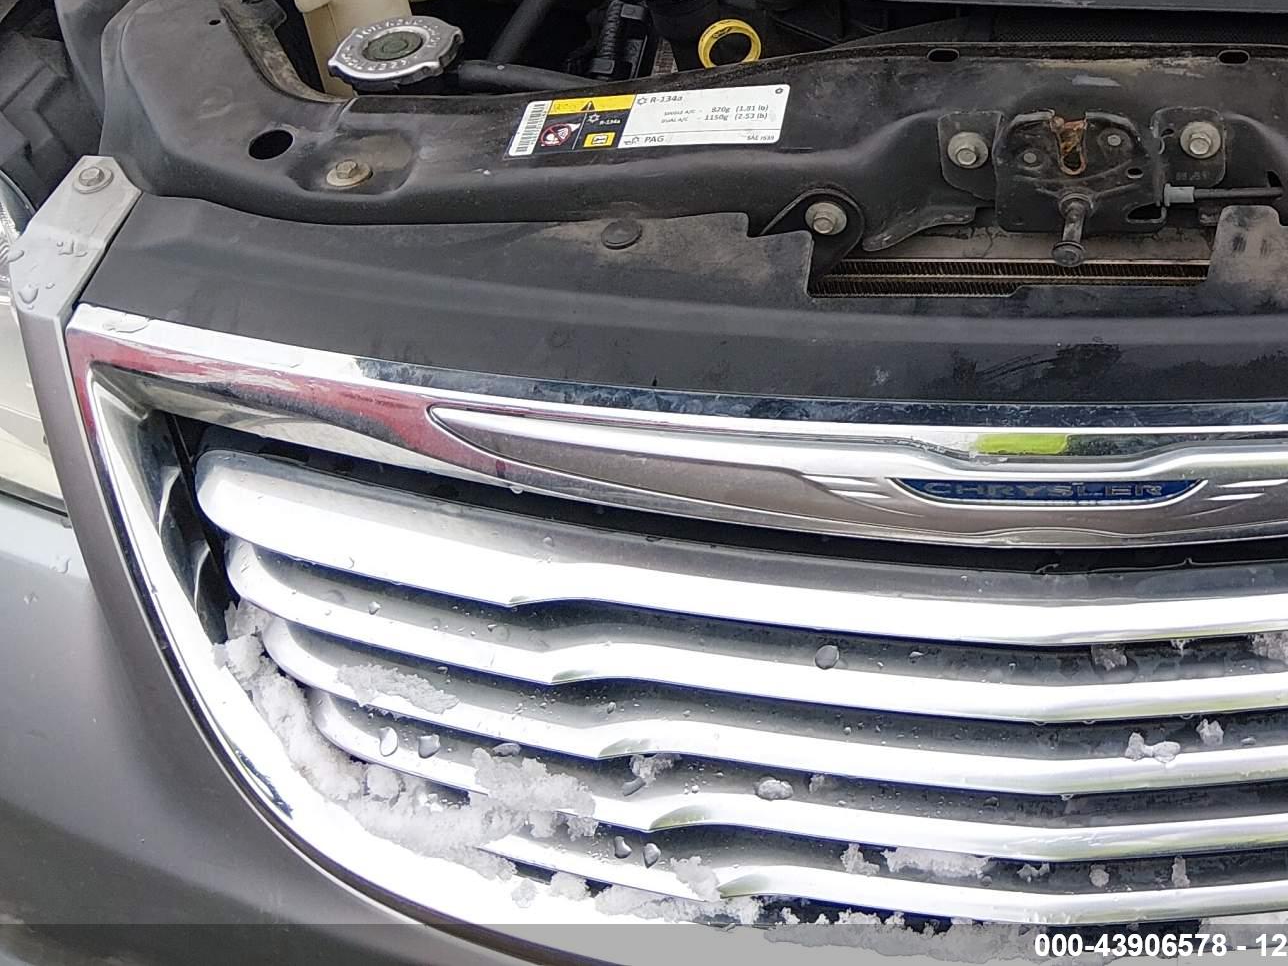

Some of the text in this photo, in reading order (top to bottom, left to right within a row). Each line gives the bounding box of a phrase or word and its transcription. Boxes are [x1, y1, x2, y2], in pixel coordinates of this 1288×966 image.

[650, 95, 683, 103] R-134a
[644, 135, 665, 143] PAG
[924, 482, 1163, 497] CHRYSLER
